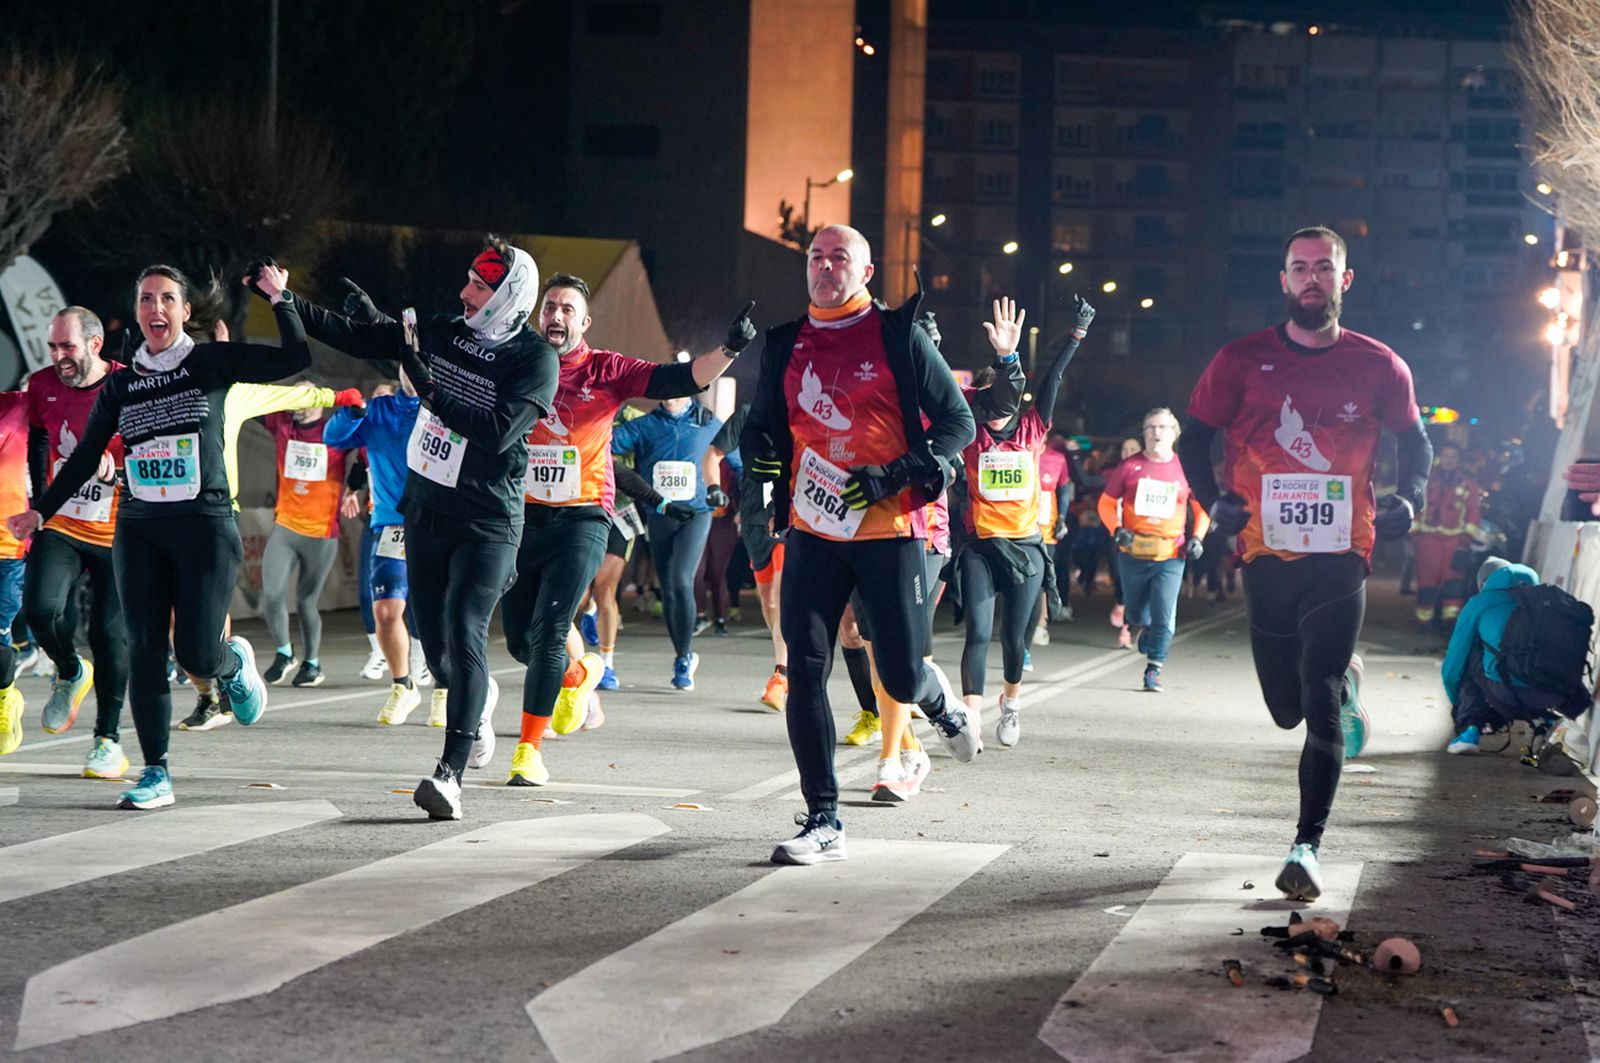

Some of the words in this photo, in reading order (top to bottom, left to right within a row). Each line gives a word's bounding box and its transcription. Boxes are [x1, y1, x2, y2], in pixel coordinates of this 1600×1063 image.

[453, 335, 496, 362] LUISILLO
[812, 400, 833, 420] 43
[1290, 437, 1313, 459] 43
[138, 459, 186, 479] 8826
[532, 466, 566, 483] 1977
[805, 467, 819, 478] SAN
[815, 464, 837, 482] NOCHE
[991, 469, 1022, 484] 7156
[660, 476, 688, 487] 2380
[804, 478, 850, 522] 2864
[1272, 492, 1288, 501] SAN
[1280, 502, 1334, 526] 5319
